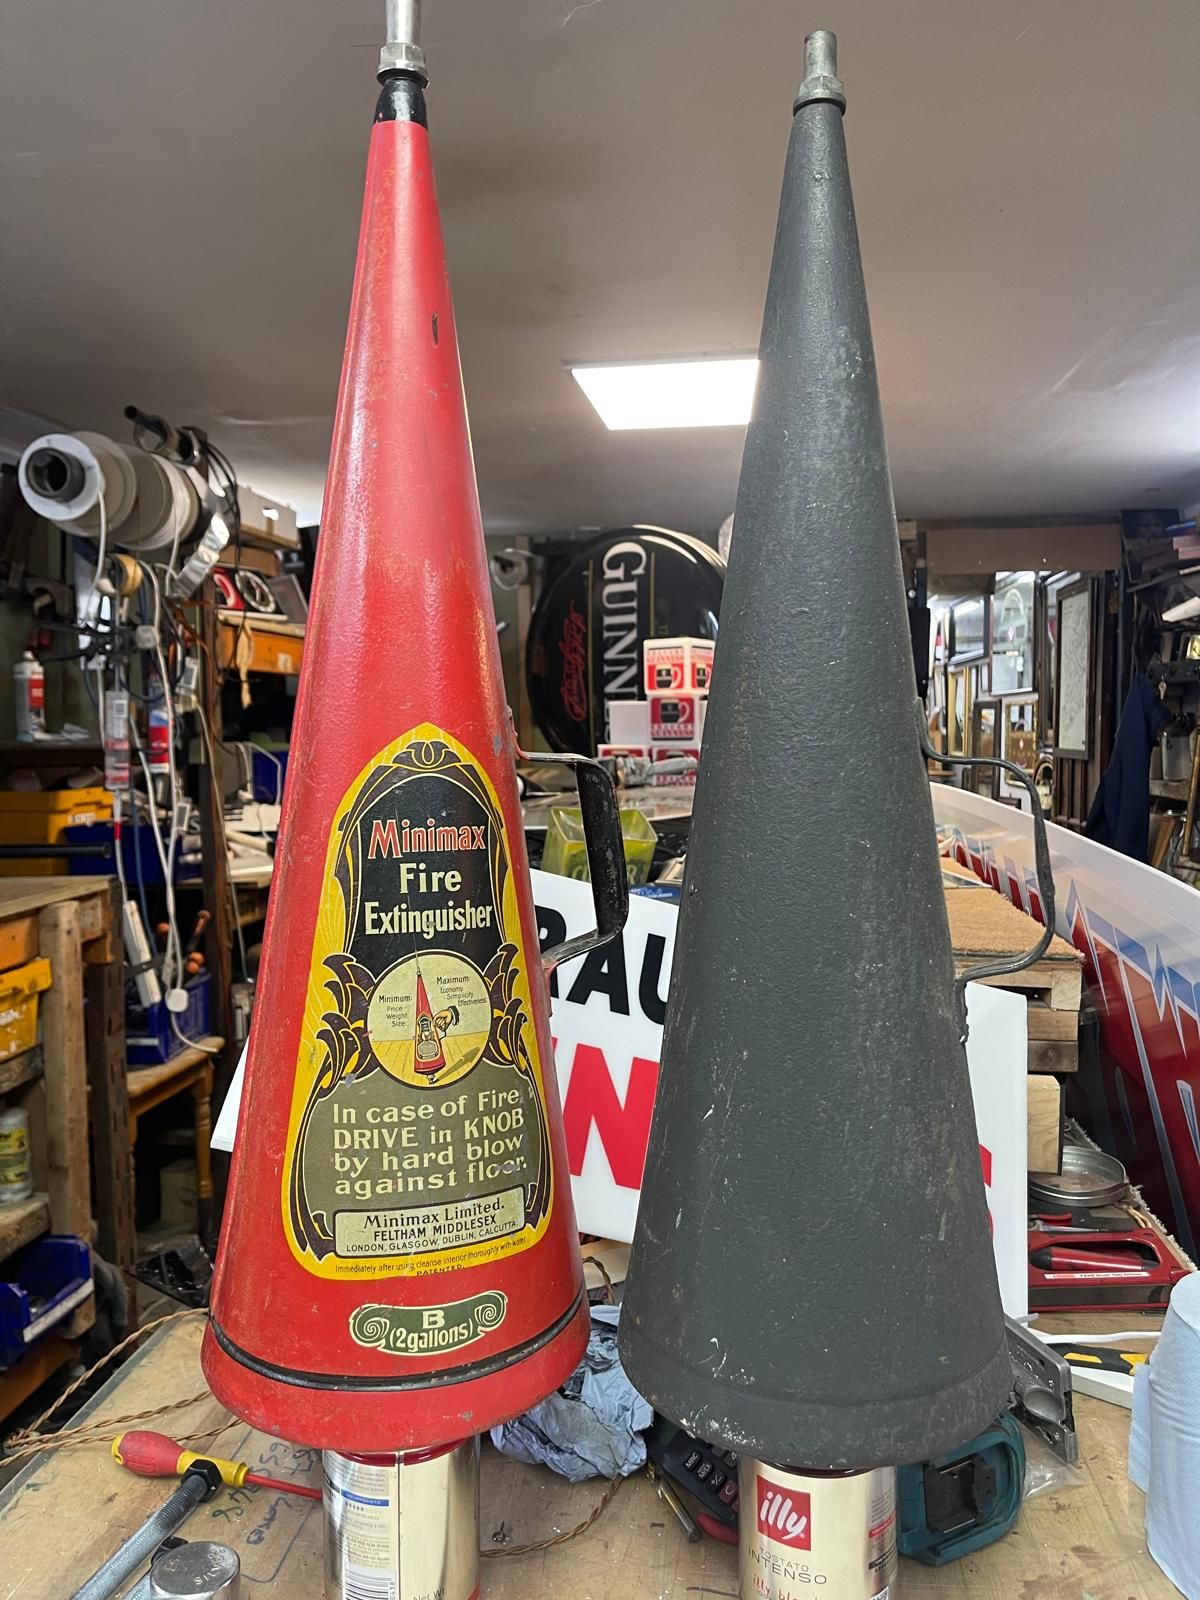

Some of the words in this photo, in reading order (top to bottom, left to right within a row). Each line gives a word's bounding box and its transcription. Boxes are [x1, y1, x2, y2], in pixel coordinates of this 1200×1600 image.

[602, 541, 648, 743] GUINN
[367, 818, 486, 860] Minimax
[399, 862, 462, 894] Fire
[364, 900, 493, 940] Extinguisher
[333, 1103, 356, 1124] In
[366, 1104, 434, 1123] case
[440, 1095, 468, 1117] of
[334, 1126, 419, 1149] DRIVE
[430, 1126, 451, 1145] in
[464, 1107, 524, 1140] KNOB
[334, 1153, 369, 1178] by
[382, 1145, 453, 1171] hard
[466, 1134, 524, 1161] blow
[335, 1168, 458, 1200] against
[363, 1213, 439, 1229] Minimax
[444, 1197, 504, 1221] Limited.
[374, 1226, 426, 1241] FELTHAM
[433, 1213, 497, 1236] MIDDLESEX
[346, 1243, 387, 1252] LONDON,
[388, 1238, 440, 1250] GLASGOW,
[442, 1231, 477, 1245] DUBLIN,
[478, 1220, 519, 1237] CALCUTTA.
[335, 1264, 376, 1275] Immediately
[378, 1262, 394, 1271] after
[416, 1258, 442, 1268] cleanse
[443, 1254, 467, 1264] interior
[467, 1246, 499, 1260] thoroughly
[500, 1240, 512, 1251] with
[422, 1309, 445, 1329] B
[760, 1491, 807, 1540] illy
[748, 1547, 828, 1585] INTENSO
[760, 1547, 809, 1572] TOSTATO
